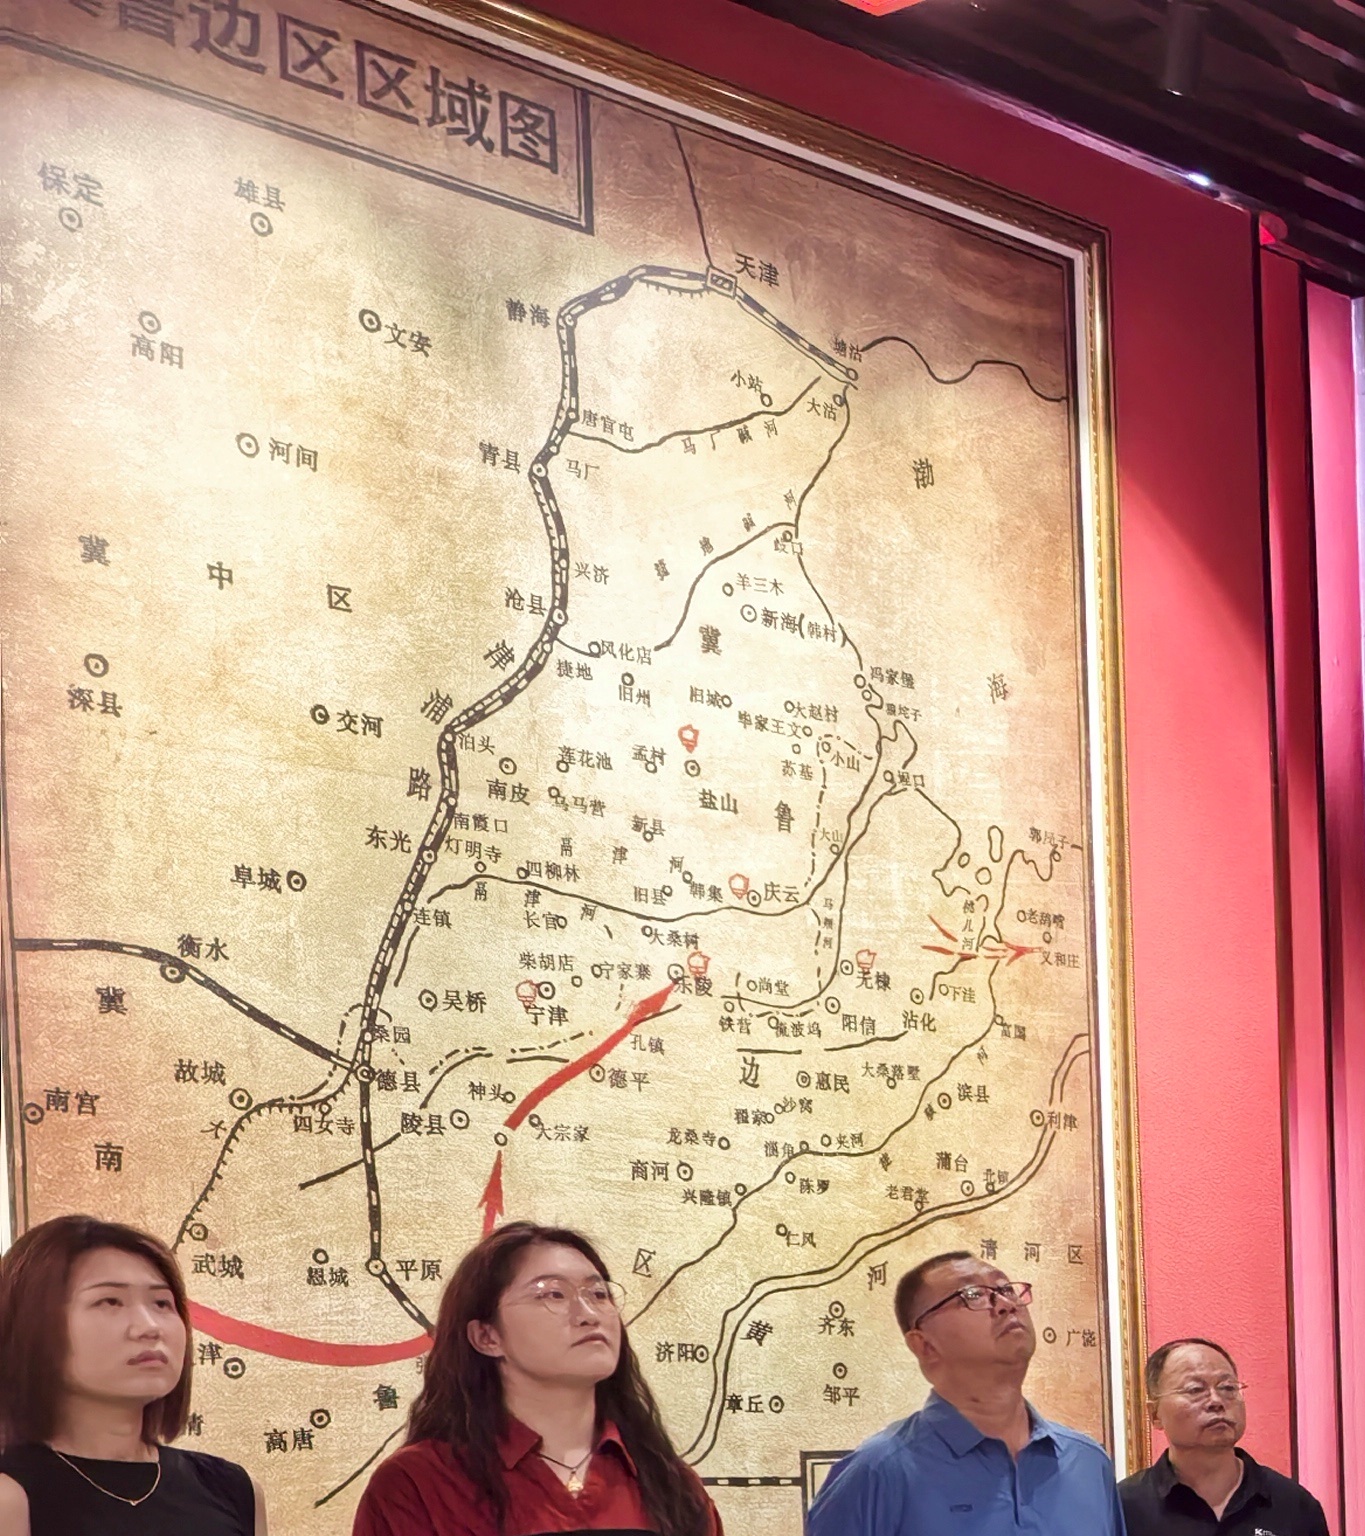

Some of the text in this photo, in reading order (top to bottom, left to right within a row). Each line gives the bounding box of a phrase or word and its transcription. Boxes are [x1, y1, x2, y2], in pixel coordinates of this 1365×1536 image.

[68, 0, 559, 174] 边区区域图
[37, 161, 104, 208] 保定
[234, 176, 286, 213] 雄县
[735, 253, 780, 288] 天津
[505, 297, 551, 328] 静海
[131, 331, 185, 369] 高阳
[384, 323, 433, 358] 文安
[731, 369, 763, 394] 小站
[806, 397, 837, 422] 大沽
[582, 409, 634, 441] 唐官屯
[268, 437, 319, 473] 河间
[479, 438, 521, 474] 青县
[566, 458, 599, 481] 马厂
[574, 561, 610, 585] 兴济
[736, 572, 784, 596] 羊三木
[504, 586, 547, 617] 沧县
[601, 639, 651, 666] 风化店
[556, 658, 594, 681] 捷地
[869, 665, 915, 690] 冯家堡
[66, 683, 123, 718] 深县
[618, 683, 651, 708] 旧州
[689, 685, 724, 710] 旧城
[336, 709, 384, 738] 交河
[737, 709, 803, 739] 毕家王文
[792, 702, 838, 723] 大赵村
[458, 732, 495, 756] 泊头
[631, 744, 667, 766] 孟村
[558, 745, 613, 771] 莲花池
[830, 750, 861, 773] 小山
[781, 759, 814, 781] 苏基
[486, 778, 531, 805] 南皮
[699, 788, 739, 815] 盐山
[552, 793, 607, 818] 乌马营
[631, 815, 666, 837] 新县
[820, 826, 843, 843] 大山
[365, 825, 412, 854] 东光
[445, 836, 502, 863] 灯明寺
[230, 864, 283, 894] 阜城
[525, 860, 581, 883] 四柳林
[633, 886, 667, 906] 旧县
[690, 881, 723, 903] 韩集
[763, 881, 800, 903] 庆云
[413, 906, 452, 930] 连镇
[523, 910, 559, 930] 长官
[177, 933, 230, 962] 衡水
[649, 928, 700, 950] 大桑树
[519, 951, 575, 972] 柴胡店
[600, 961, 652, 981] 宁家寨
[1040, 951, 1081, 969] 义和庄
[675, 975, 713, 998] 乐陵
[758, 976, 790, 996] 尚堂
[855, 972, 891, 991] 无棣
[442, 990, 487, 1013] 吴桥
[949, 985, 976, 1003] 下洼
[527, 1005, 569, 1026] 宁津
[719, 1016, 752, 1035] 铁营
[841, 1013, 876, 1035] 阳信
[902, 1010, 937, 1032] 沾化
[372, 1024, 411, 1044] 桑园
[630, 1033, 665, 1055] 孔镇
[173, 1058, 227, 1087] 故城
[376, 1069, 421, 1093] 德县
[607, 1067, 650, 1091] 德平
[815, 1071, 851, 1094] 惠民
[44, 1086, 100, 1117] 南宫
[468, 1081, 504, 1102] 神头
[957, 1082, 990, 1103] 滨县
[293, 1114, 356, 1137] 四女寺
[401, 1112, 447, 1136] 陵县
[535, 1123, 590, 1143] 大宗家
[1046, 1111, 1078, 1132] 利津
[666, 1127, 717, 1147] 龙桑寺
[630, 1159, 669, 1182] 商河
[935, 1150, 968, 1173] 蒲台
[682, 1188, 733, 1208] 兴隆镇
[786, 1230, 817, 1249] 仁风
[192, 1252, 245, 1280] 武城
[306, 1265, 349, 1289] 恩城
[395, 1259, 443, 1282] 平原
[817, 1315, 855, 1337] 齐东
[1066, 1328, 1096, 1348] 广饶
[194, 1342, 223, 1366] 津
[656, 1341, 695, 1364] 济阳
[726, 1392, 764, 1414] 章丘
[822, 1383, 860, 1407] 邹平
[264, 1428, 315, 1453] 高唐
